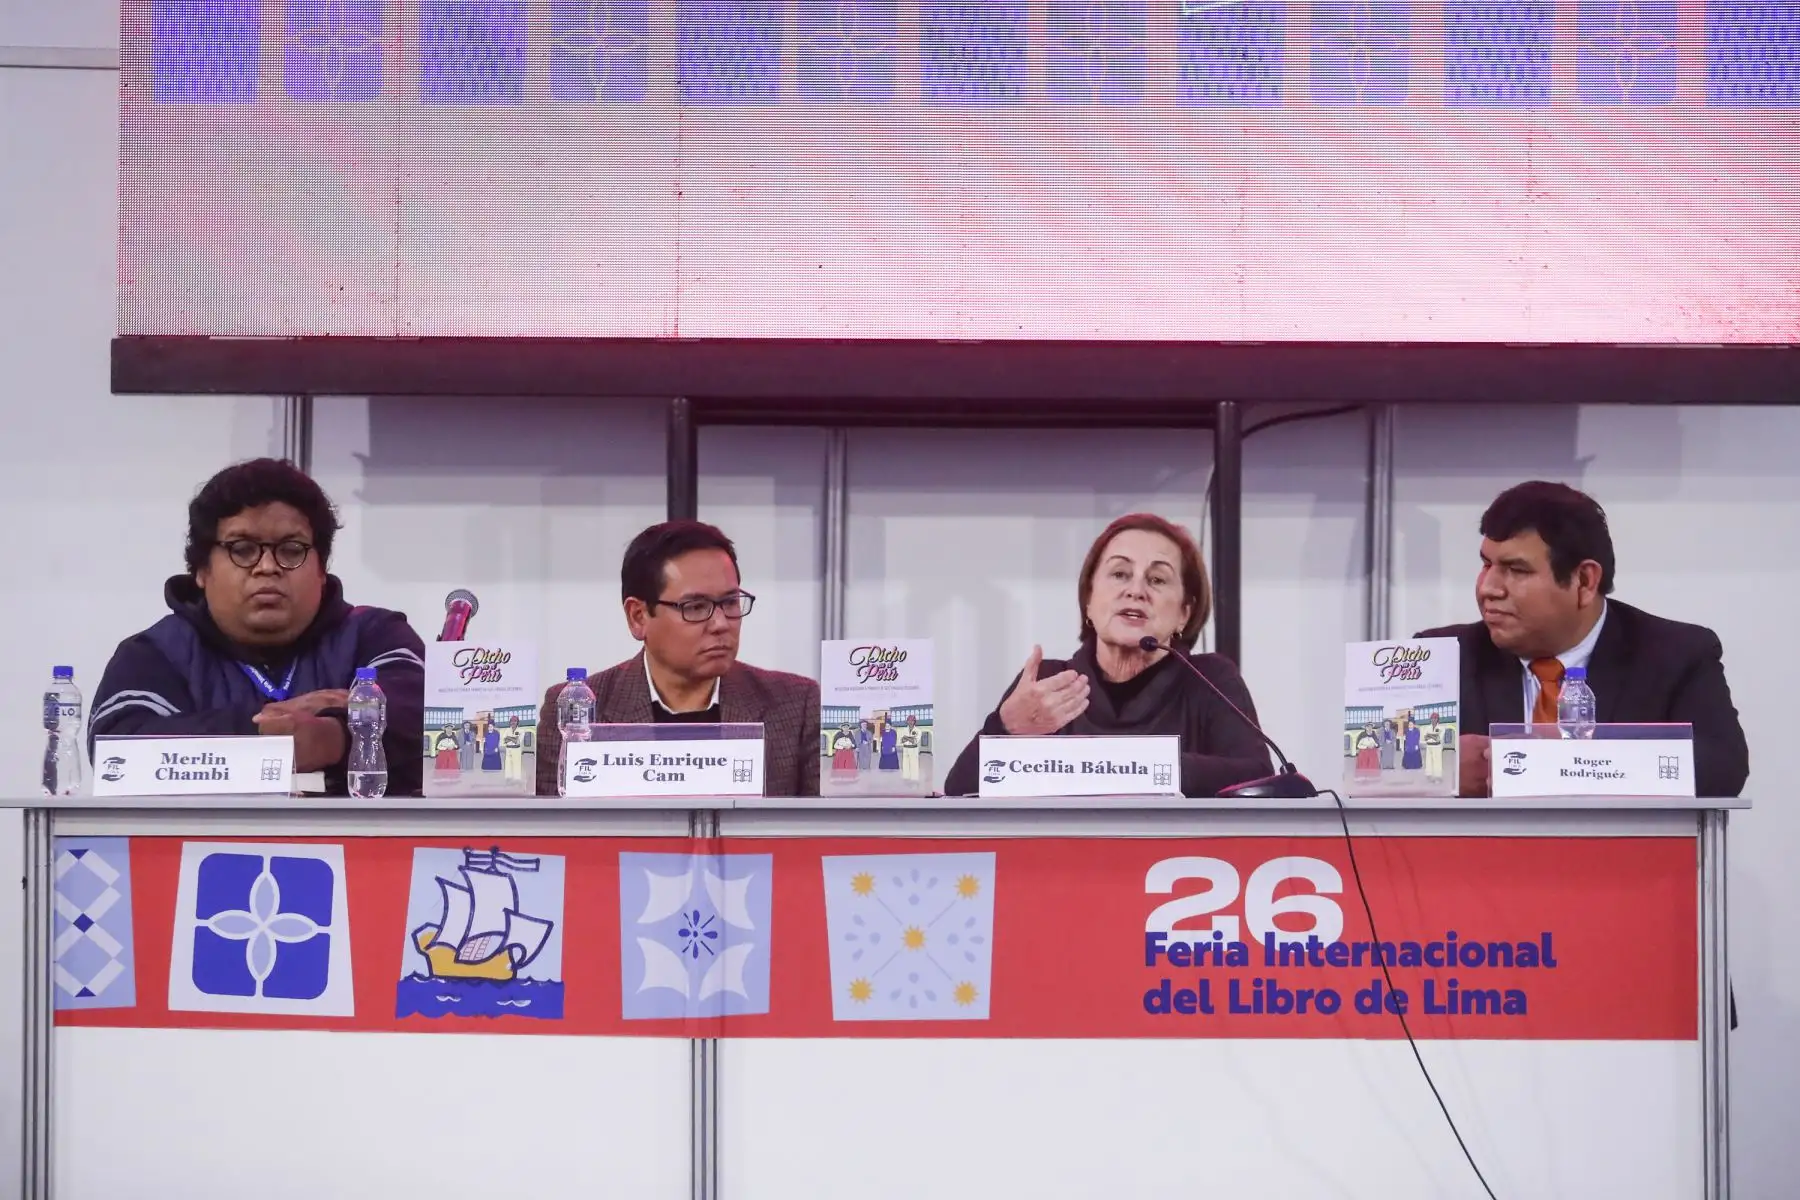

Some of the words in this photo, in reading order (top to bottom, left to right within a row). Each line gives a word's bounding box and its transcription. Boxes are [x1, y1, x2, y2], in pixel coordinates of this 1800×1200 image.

[161, 752, 226, 765] Merlin
[603, 753, 644, 766] Luis
[650, 753, 728, 770] Enrique
[1573, 756, 1612, 768] Roger
[155, 767, 229, 781] Chambi
[1009, 759, 1075, 774] Cecilia
[1080, 760, 1149, 775] Bákula
[1560, 767, 1627, 780] Rodriguéz
[642, 769, 686, 782] Cam
[1145, 856, 1343, 953] 26
[1144, 931, 1249, 967] Feria
[1264, 930, 1557, 968] Internacional
[1143, 979, 1214, 1015] del
[1229, 978, 1341, 1015] Libro
[1354, 978, 1409, 1015] de
[1424, 978, 1527, 1015] Lima
